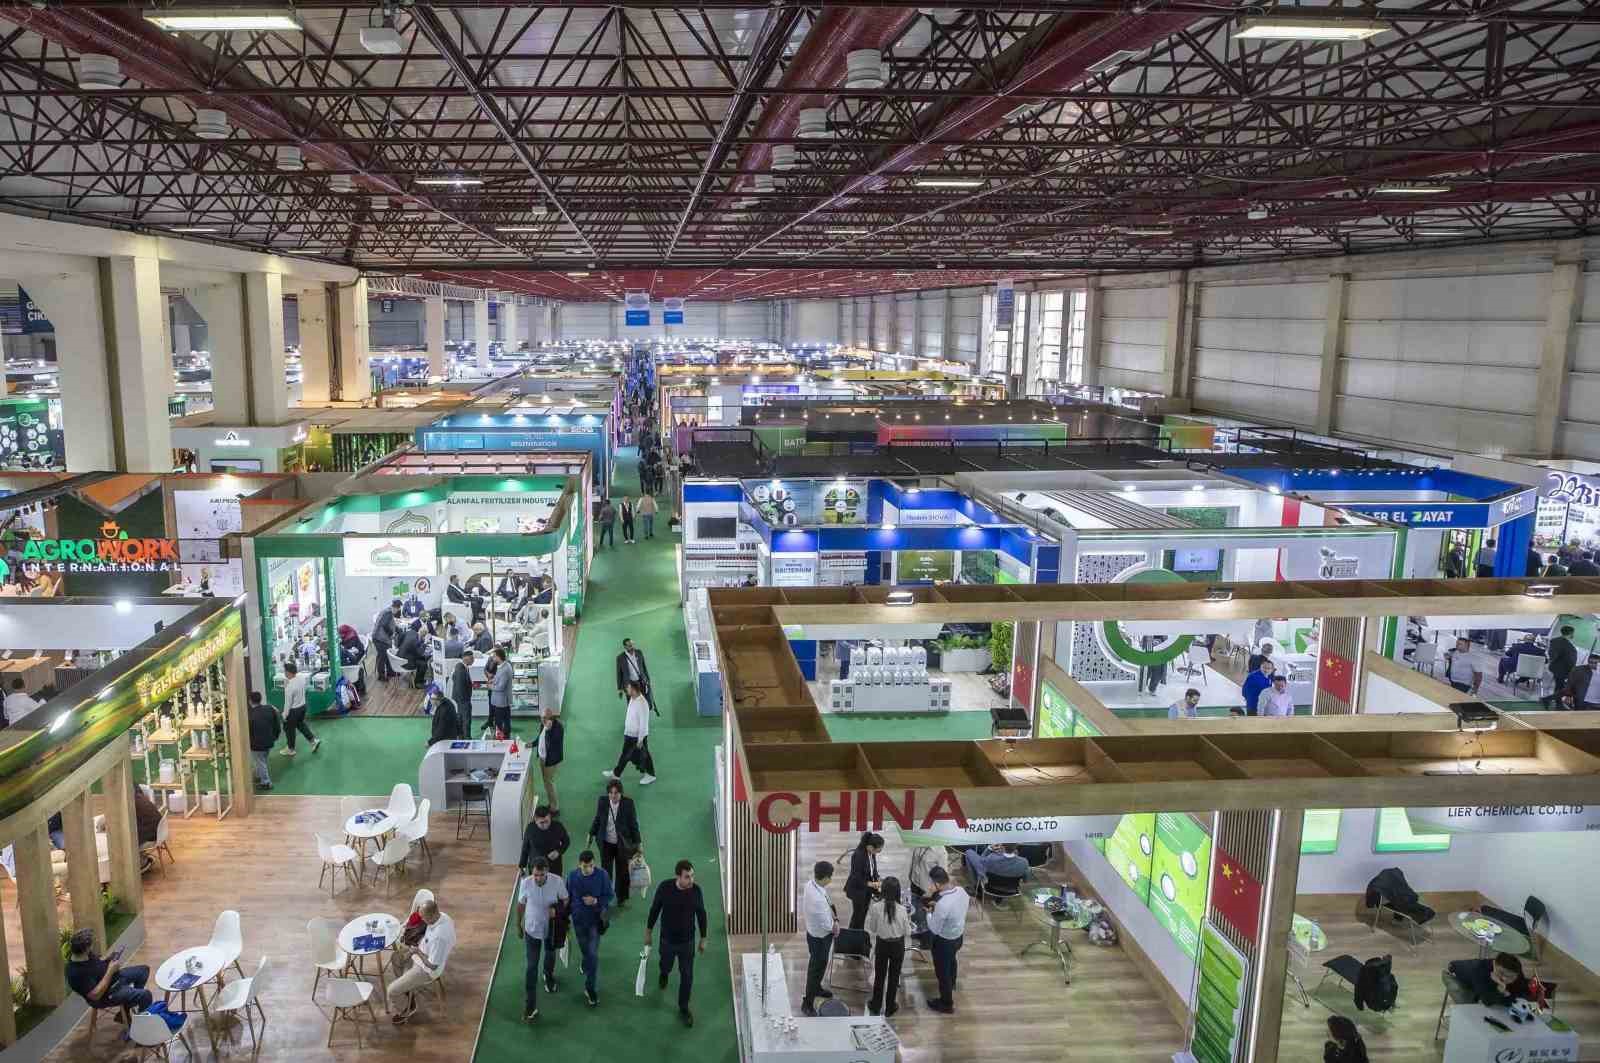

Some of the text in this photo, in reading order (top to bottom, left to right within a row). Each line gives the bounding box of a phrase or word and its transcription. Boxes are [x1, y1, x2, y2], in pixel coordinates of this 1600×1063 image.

[481, 497, 520, 505] FERTILIZER
[1393, 511, 1408, 522] EL
[1413, 511, 1454, 522] ZAYAT
[23, 539, 180, 560] AGROWORK
[22, 562, 182, 573] INTERNATIONAL
[757, 789, 969, 835] CHINA
[1448, 807, 1472, 817] LIER
[1475, 805, 1535, 817] CHEMICAL
[964, 820, 1058, 833] TRADING CO.,LTD
